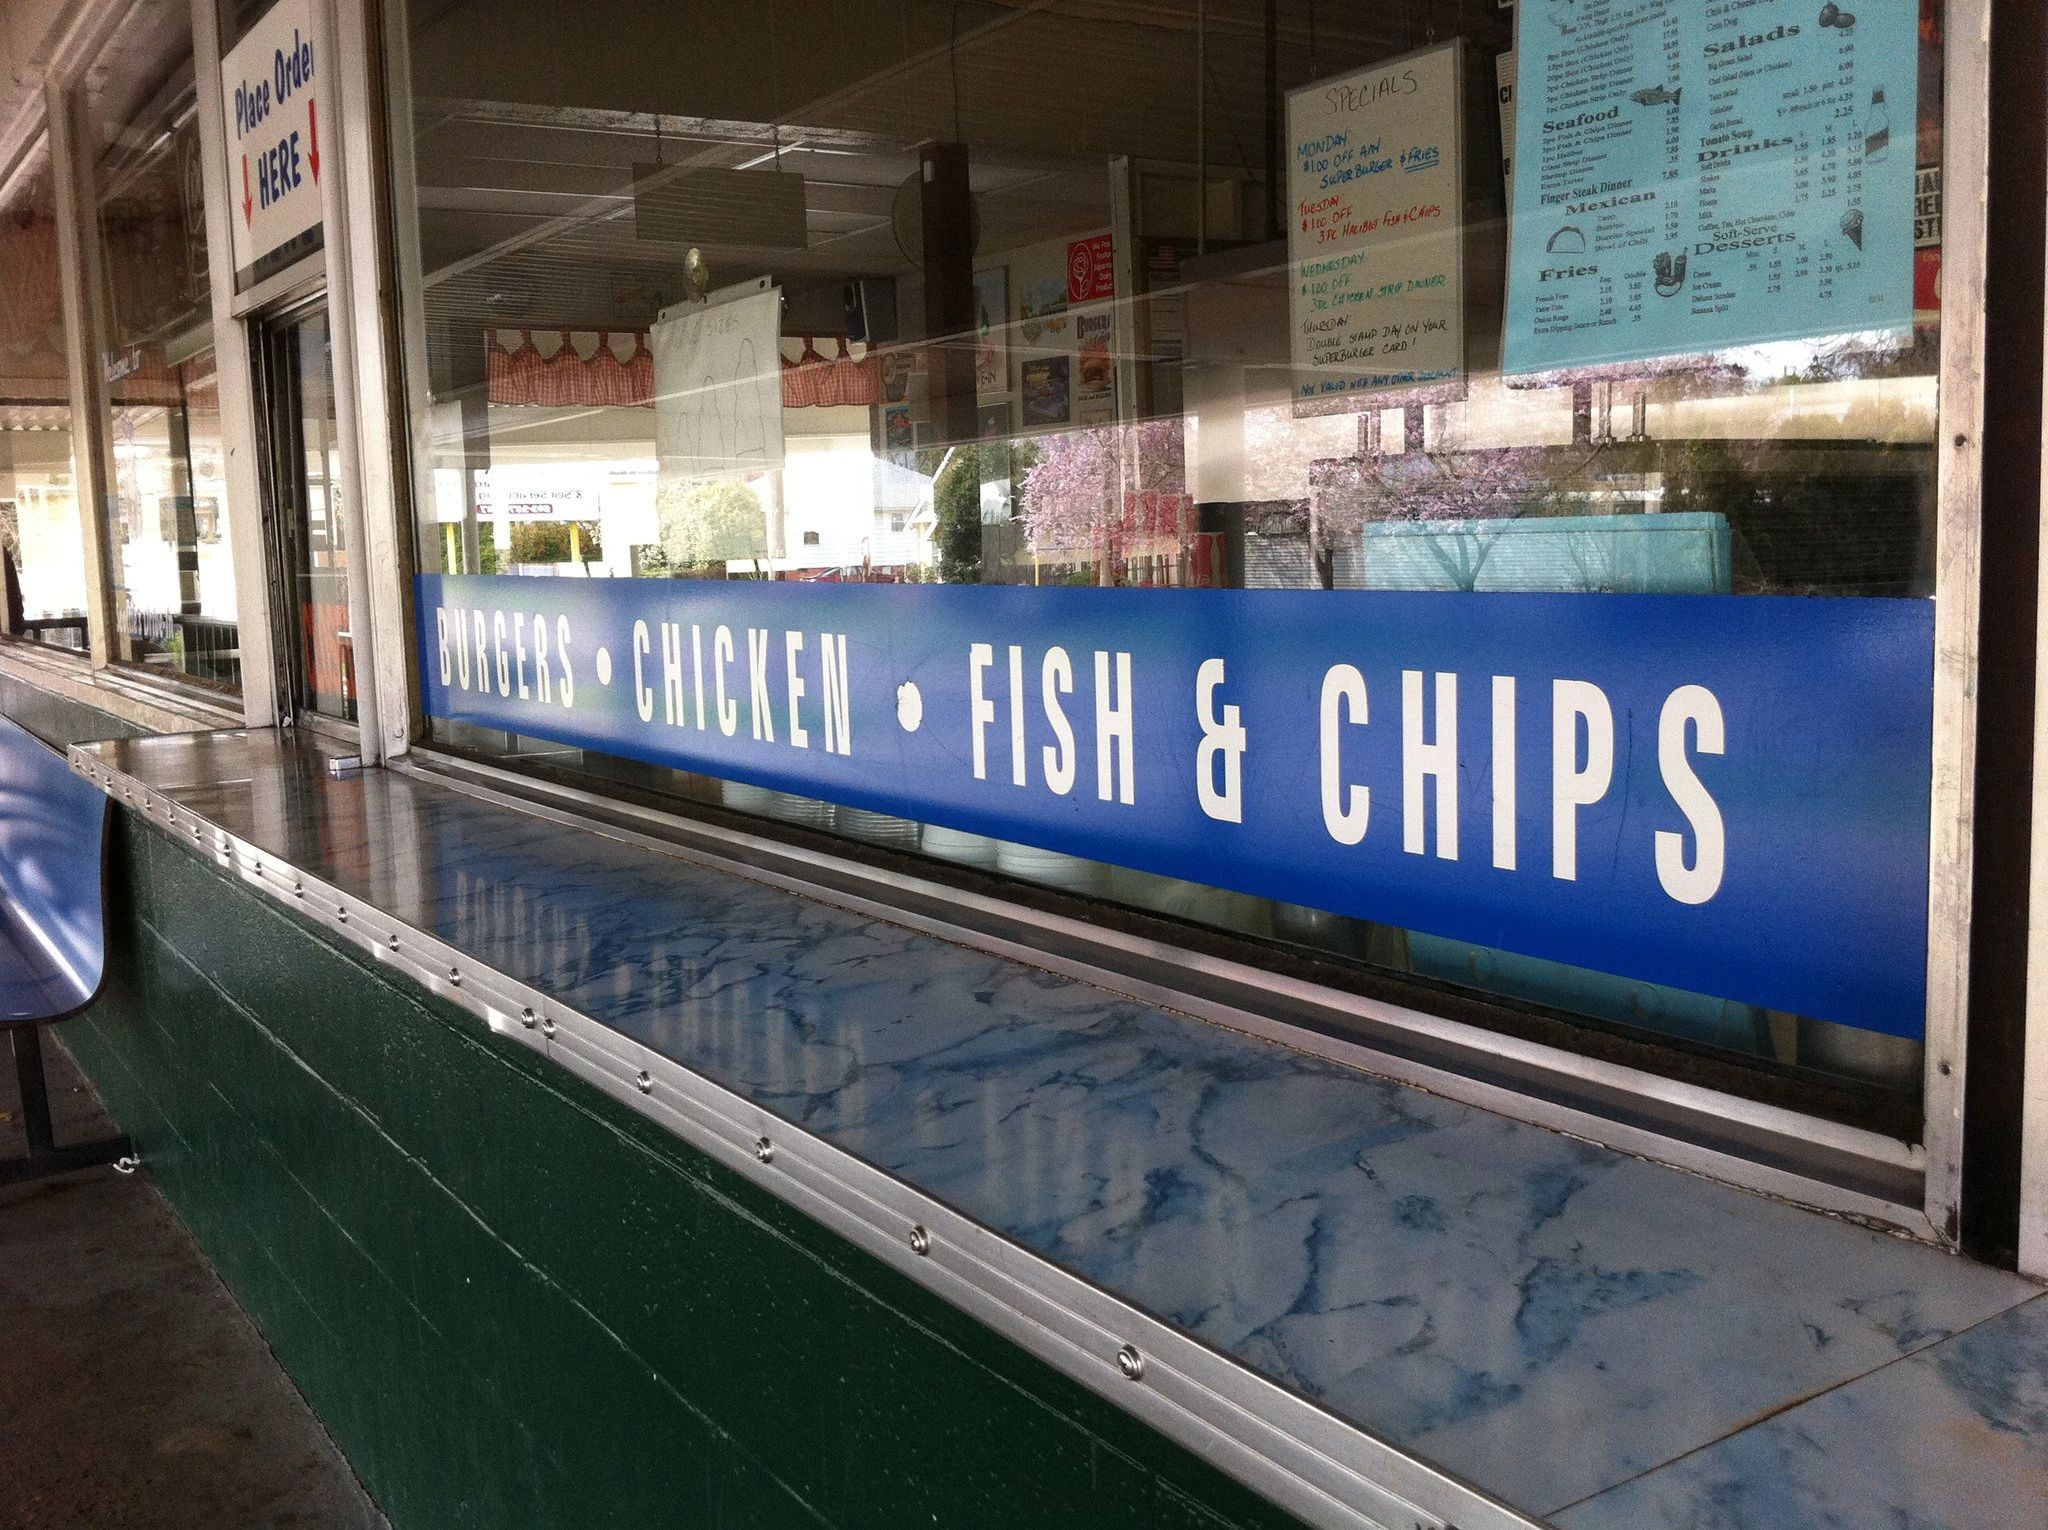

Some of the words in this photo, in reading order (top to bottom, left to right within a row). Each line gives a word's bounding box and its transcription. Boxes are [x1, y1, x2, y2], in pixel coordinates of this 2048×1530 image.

[1703, 24, 1800, 58] Salads
[1325, 70, 1418, 116] SPECIALS
[1560, 98, 1587, 111] Chicken
[235, 80, 270, 140] Place
[1542, 105, 1619, 134] Seafood
[1583, 134, 1604, 145] Chips
[1584, 125, 1604, 136] Chips
[1700, 132, 1728, 149] Tomato
[1731, 127, 1753, 142] Soup
[1834, 106, 1853, 118] 2.25
[1333, 149, 1353, 167] OFF
[1360, 137, 1380, 157] ANY
[1407, 142, 1438, 163] FRIES
[1697, 136, 1793, 162] Drinks
[258, 131, 301, 209] HERE
[1540, 190, 1569, 206] Finger
[1571, 184, 1597, 200] Steak
[1599, 176, 1632, 194] Dinner
[1661, 169, 1678, 180] 7.85
[1564, 188, 1656, 216] Mexican
[1625, 227, 1654, 237] Special
[1693, 230, 1796, 257] Desserts
[1712, 222, 1777, 242] Soft-Serve
[1538, 262, 1598, 283] Fries
[1624, 270, 1646, 280] Double
[1306, 333, 1341, 351] DOUBLE
[1349, 327, 1377, 343] STAMP
[1382, 323, 1401, 339] DAY
[1405, 320, 1418, 334] ON
[1422, 315, 1446, 333] YOUR
[436, 606, 574, 708] BURGERS
[633, 619, 851, 756] CHICKEN
[969, 643, 1135, 805] FISH
[1195, 658, 1246, 824] &
[1320, 663, 1727, 906] CHIPS
